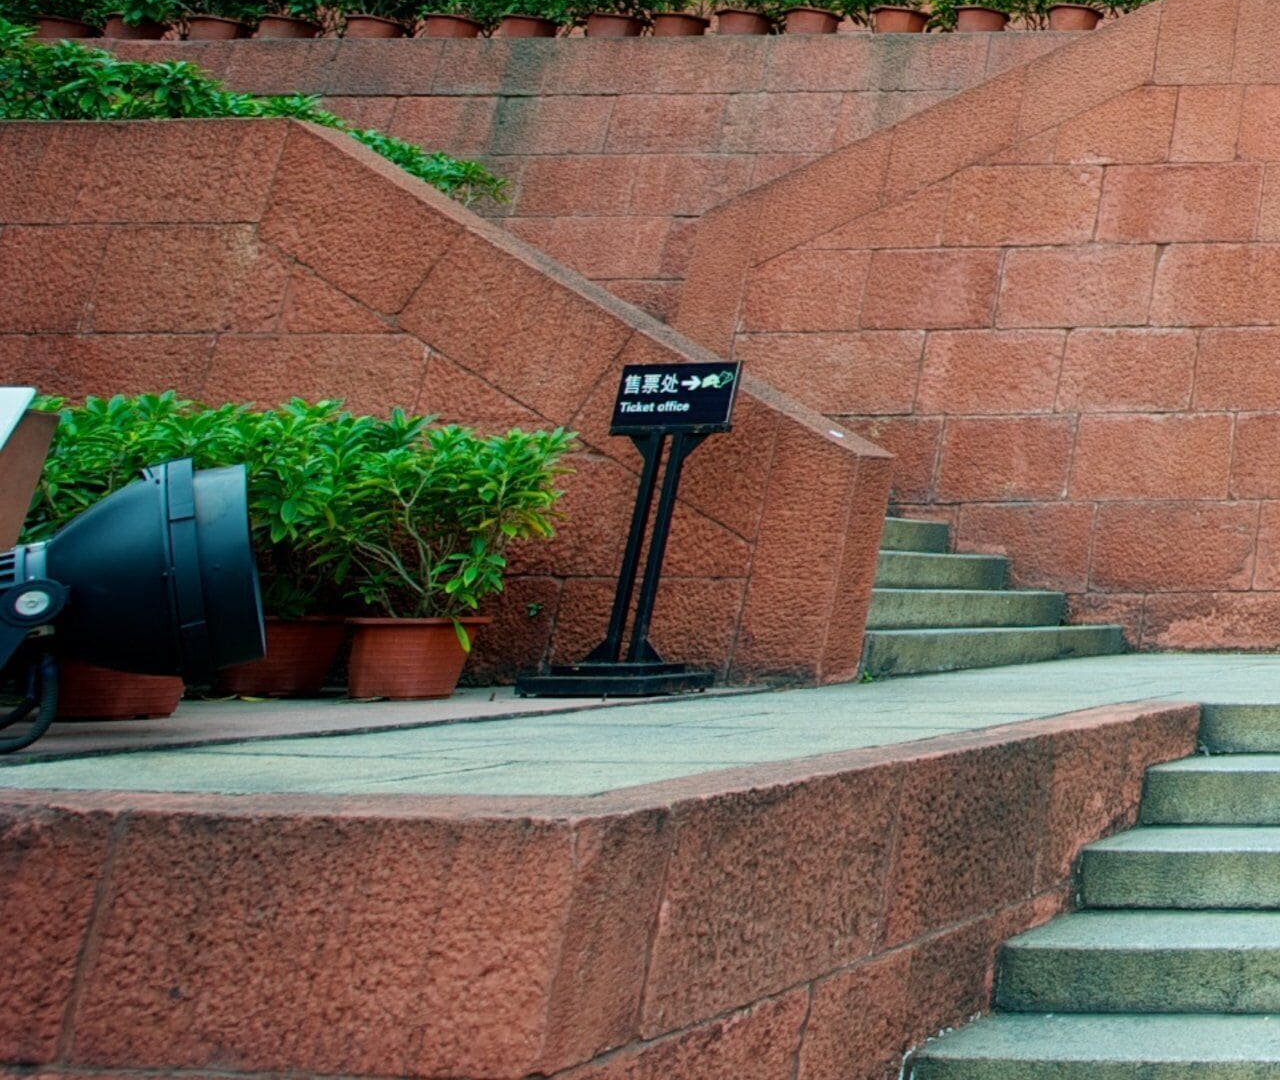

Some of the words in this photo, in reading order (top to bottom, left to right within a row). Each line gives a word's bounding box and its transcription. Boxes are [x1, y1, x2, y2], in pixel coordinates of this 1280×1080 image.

[624, 373, 679, 395] 售票处
[620, 401, 655, 413] Ticket
[657, 400, 690, 412] office
